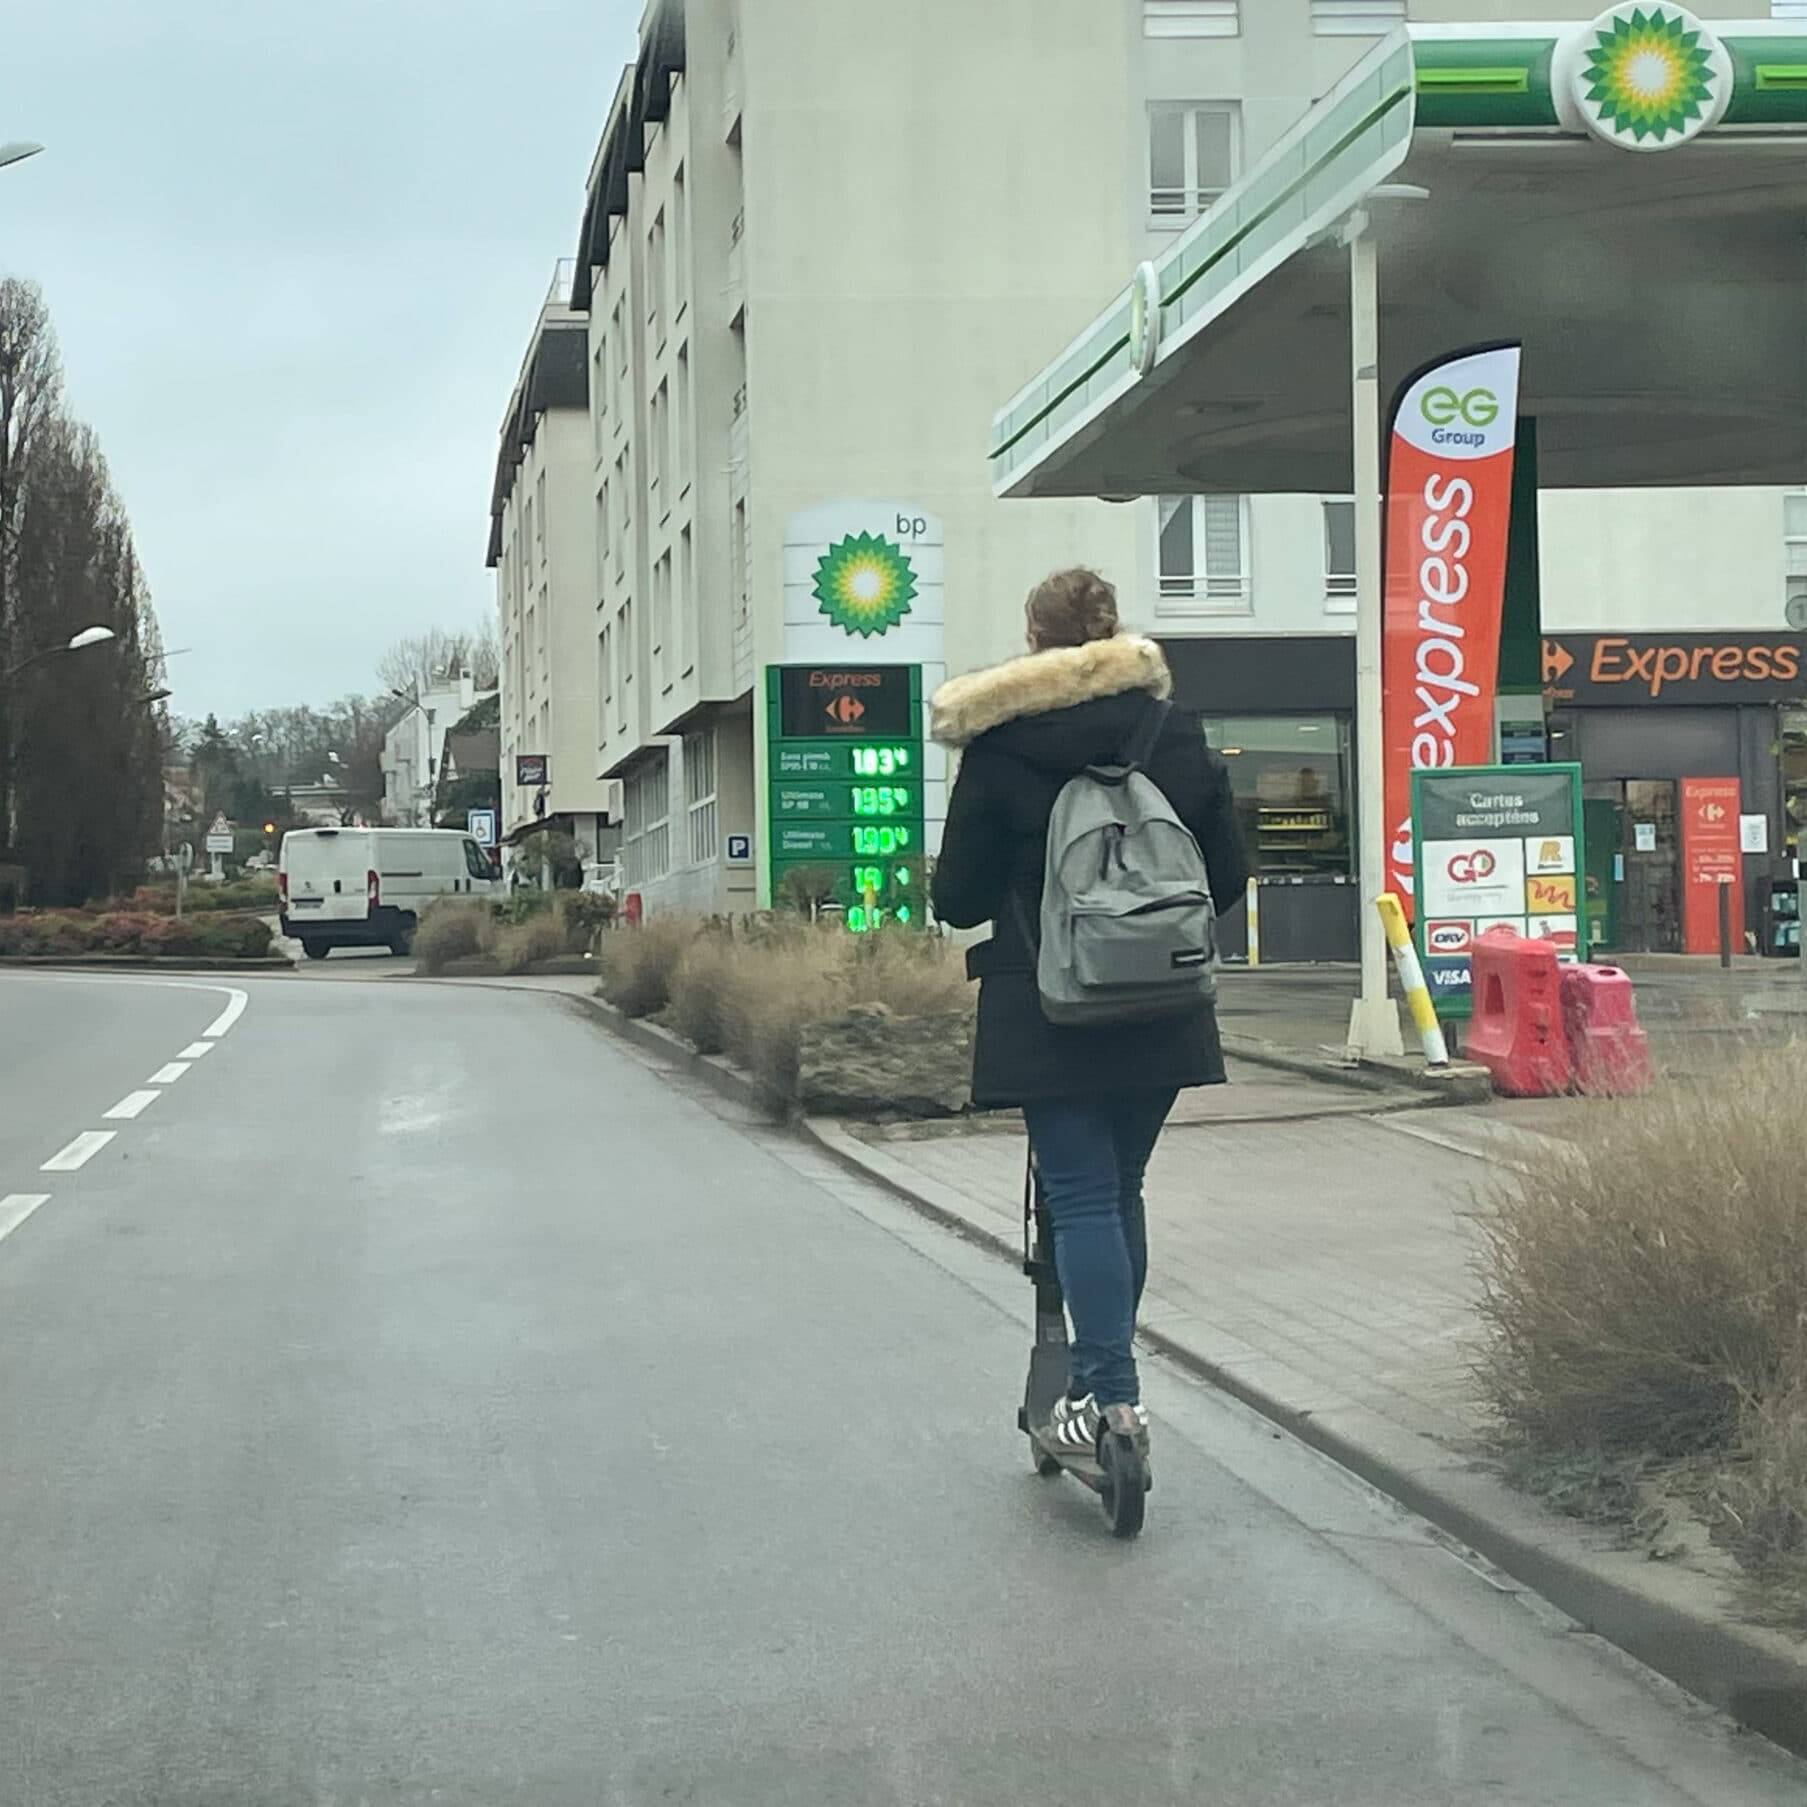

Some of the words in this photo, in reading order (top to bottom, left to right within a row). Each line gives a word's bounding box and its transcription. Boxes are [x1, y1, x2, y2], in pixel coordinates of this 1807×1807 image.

[1431, 428, 1485, 448] Group
[896, 512, 927, 540] bp
[1411, 473, 1480, 769] express
[1589, 638, 1800, 698] Express
[809, 671, 881, 690] Express
[1470, 793, 1524, 809] Cartes
[731, 839, 746, 856] P
[1432, 969, 1472, 985] VISA
